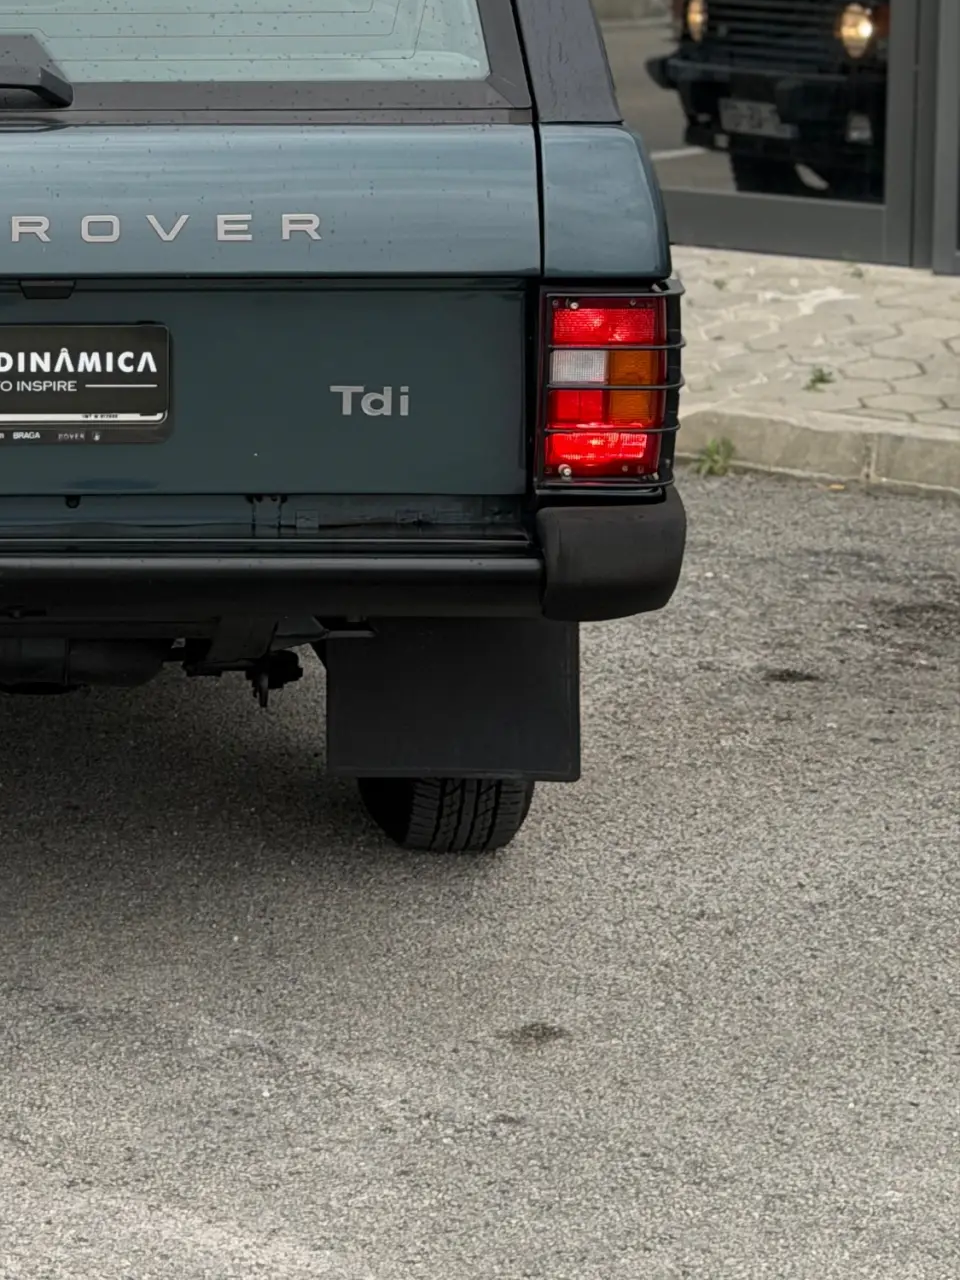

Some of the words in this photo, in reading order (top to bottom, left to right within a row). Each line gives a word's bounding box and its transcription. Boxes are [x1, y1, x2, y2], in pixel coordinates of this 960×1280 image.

[11, 213, 322, 243] ROVER
[16, 380, 77, 392] INSPIRE
[329, 385, 409, 416] Tdi
[12, 431, 41, 440] BRAGA
